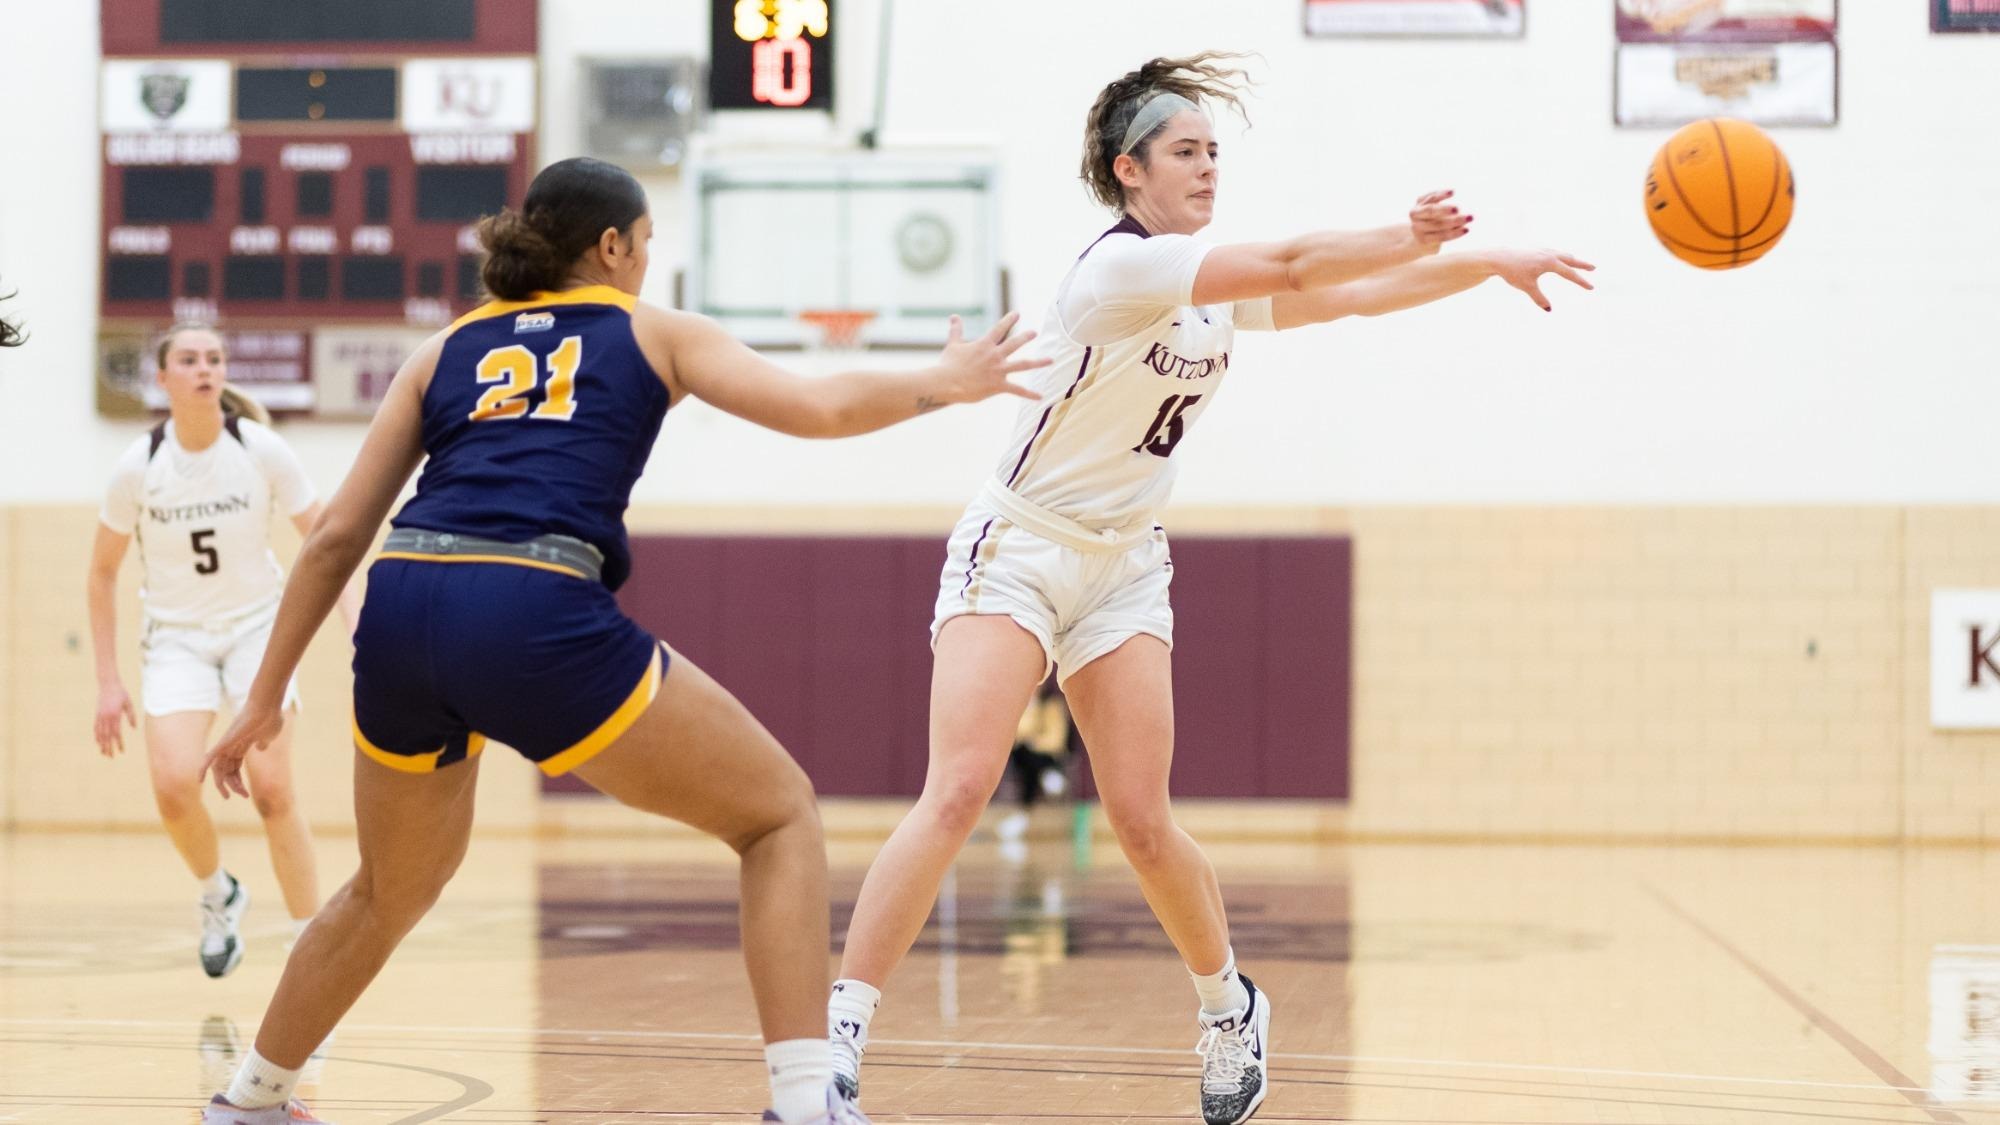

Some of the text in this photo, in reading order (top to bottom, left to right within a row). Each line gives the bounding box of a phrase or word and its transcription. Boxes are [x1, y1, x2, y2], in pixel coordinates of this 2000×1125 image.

[752, 38, 811, 106] 10
[468, 335, 582, 421] 21
[1142, 341, 1230, 380] KUTZON
[1131, 393, 1203, 458] 15
[149, 494, 249, 524] KUTZTOWN
[190, 528, 220, 576] 5
